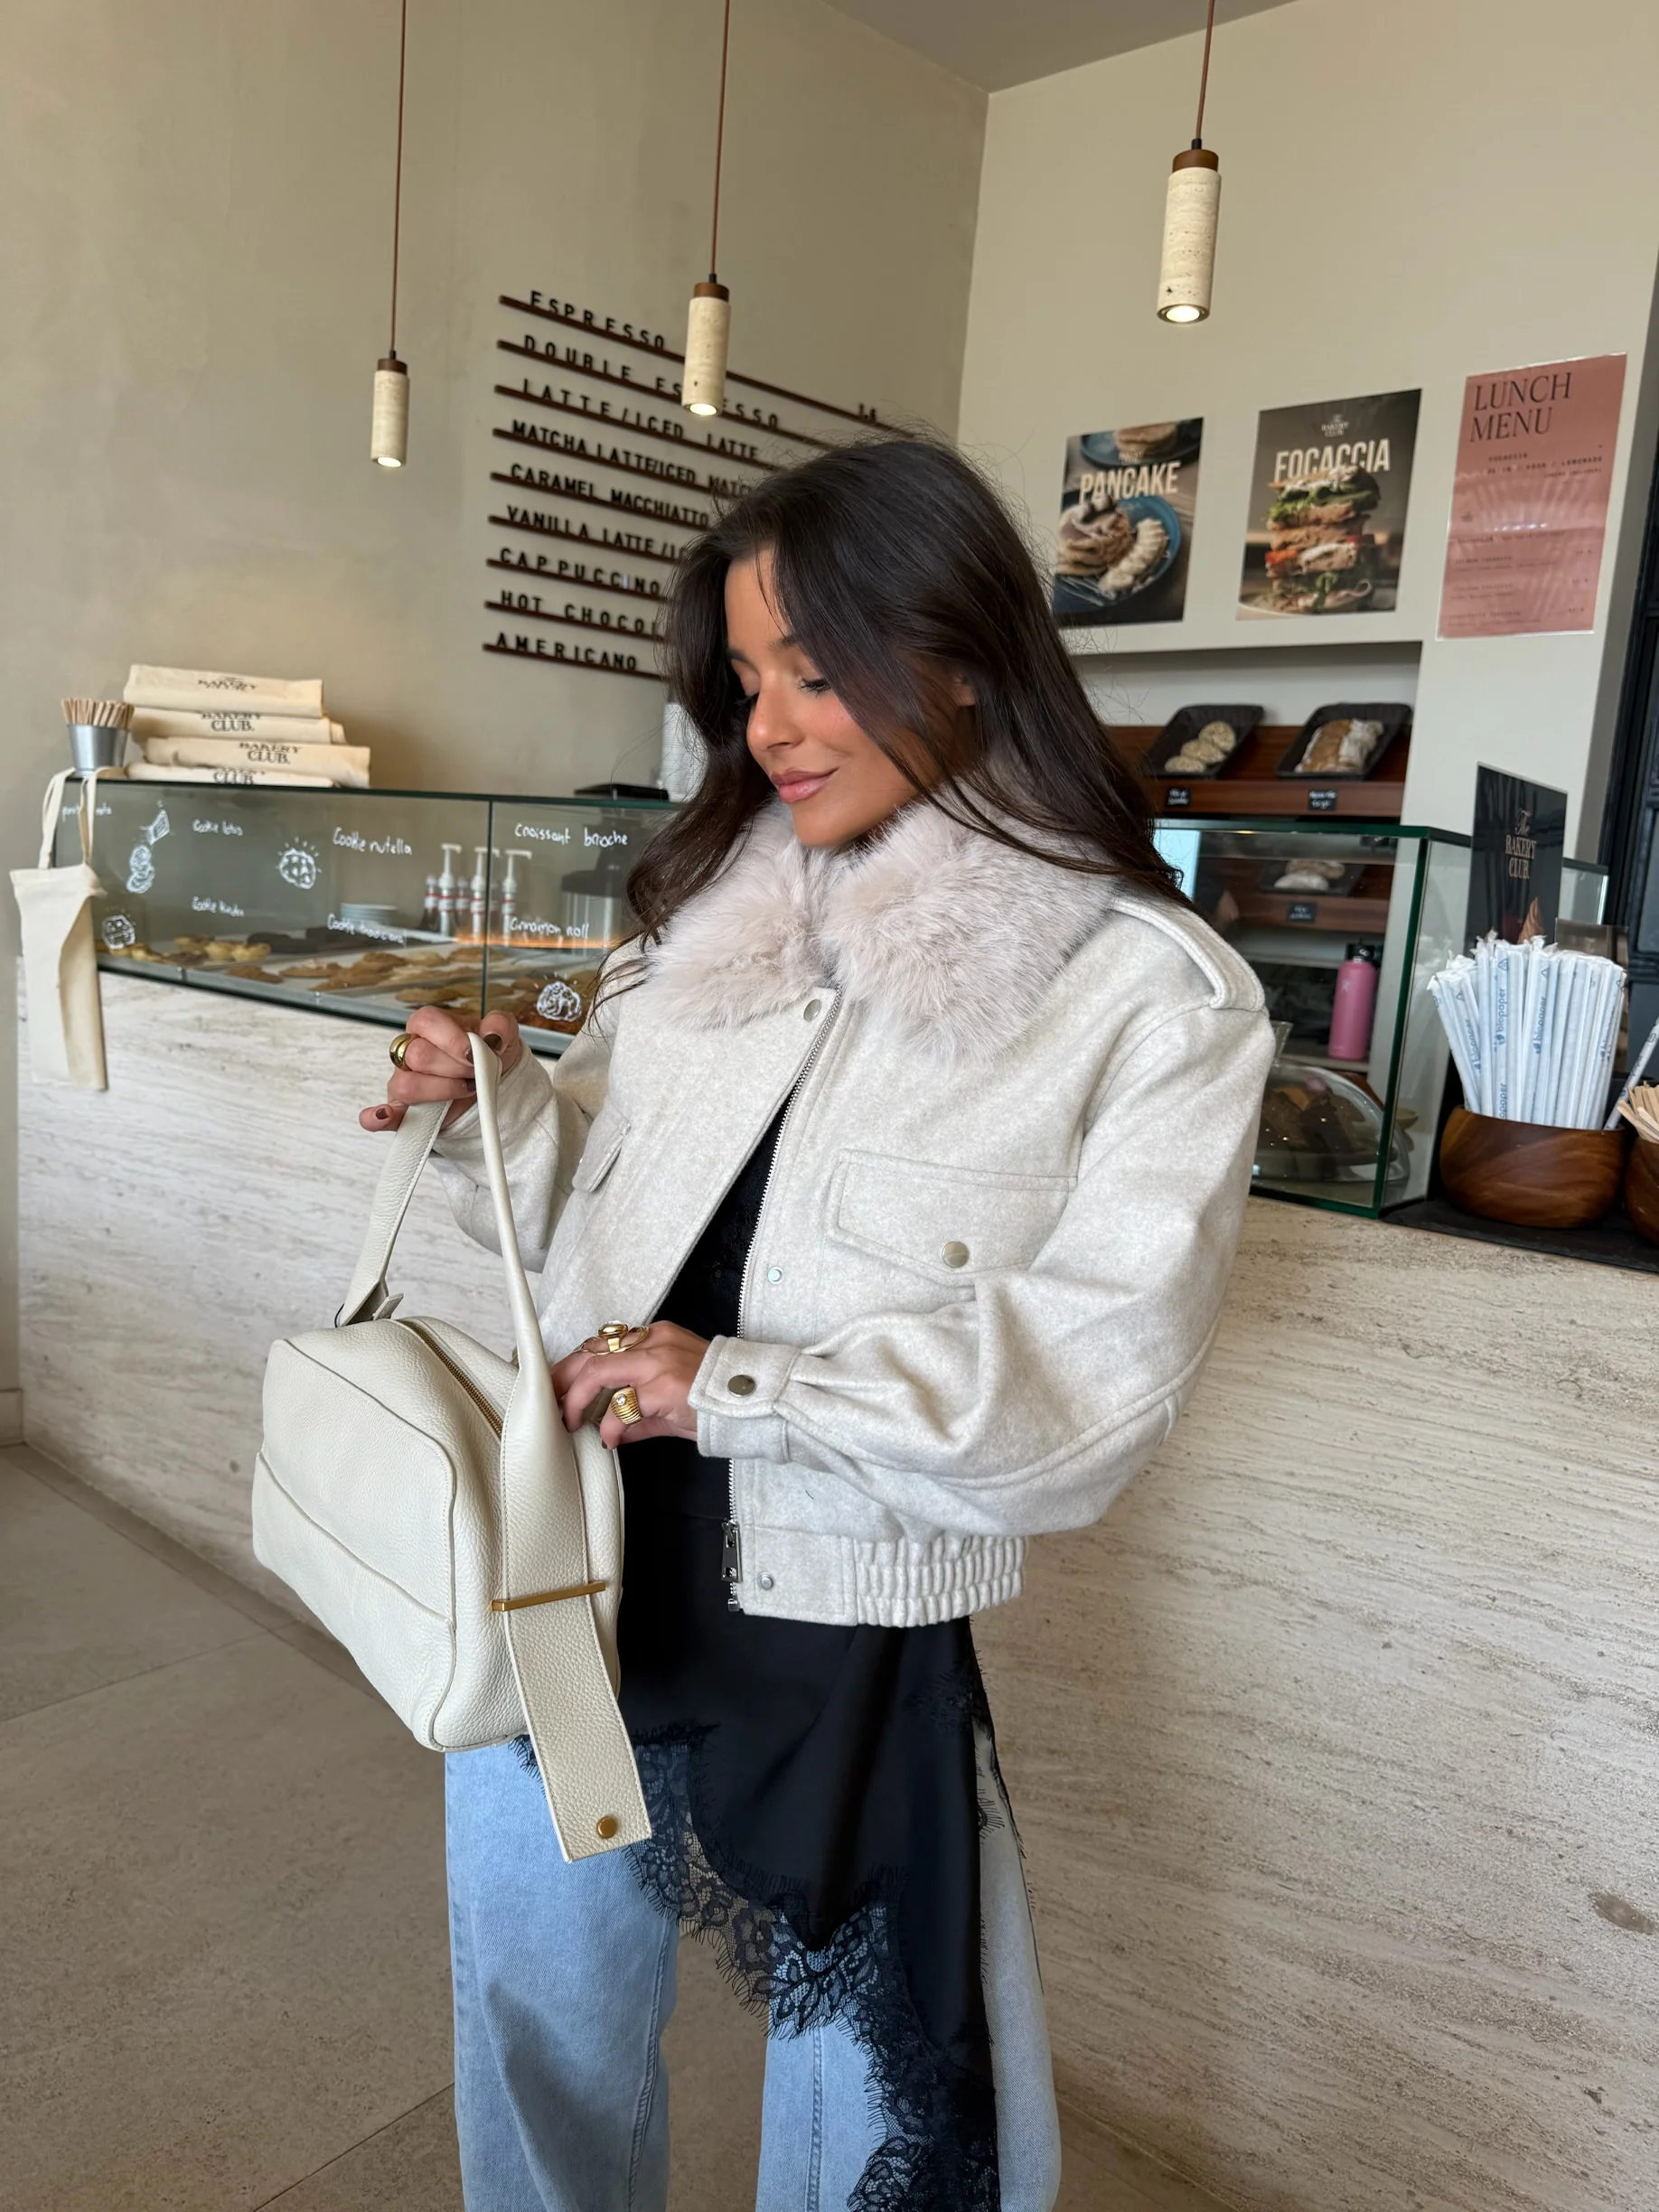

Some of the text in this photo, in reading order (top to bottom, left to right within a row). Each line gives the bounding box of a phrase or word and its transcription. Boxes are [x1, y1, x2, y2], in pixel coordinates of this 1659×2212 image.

[530, 290, 665, 349] ESPRESSO
[524, 334, 632, 381] DOUBLE
[1474, 372, 1571, 411] LUNCH
[512, 419, 586, 452] MATCHA
[1470, 407, 1552, 443] MENU
[707, 434, 758, 459] LATTE
[1273, 438, 1391, 483] FOCACCIA
[511, 464, 709, 524] CARAMEL MACCHIATTO
[1078, 460, 1181, 506] PANCAKE
[507, 504, 589, 539] VANILLA
[500, 548, 660, 595] CAPPUCCINO
[501, 590, 542, 612] HOT
[497, 633, 637, 671] AMERICANO
[239, 741, 302, 755] BAKERY
[333, 827, 413, 855] Cookie nutella
[1505, 834, 1537, 859] BAKERY
[1497, 988, 1507, 1033] biopaper
[1533, 997, 1547, 1043] biopaper
